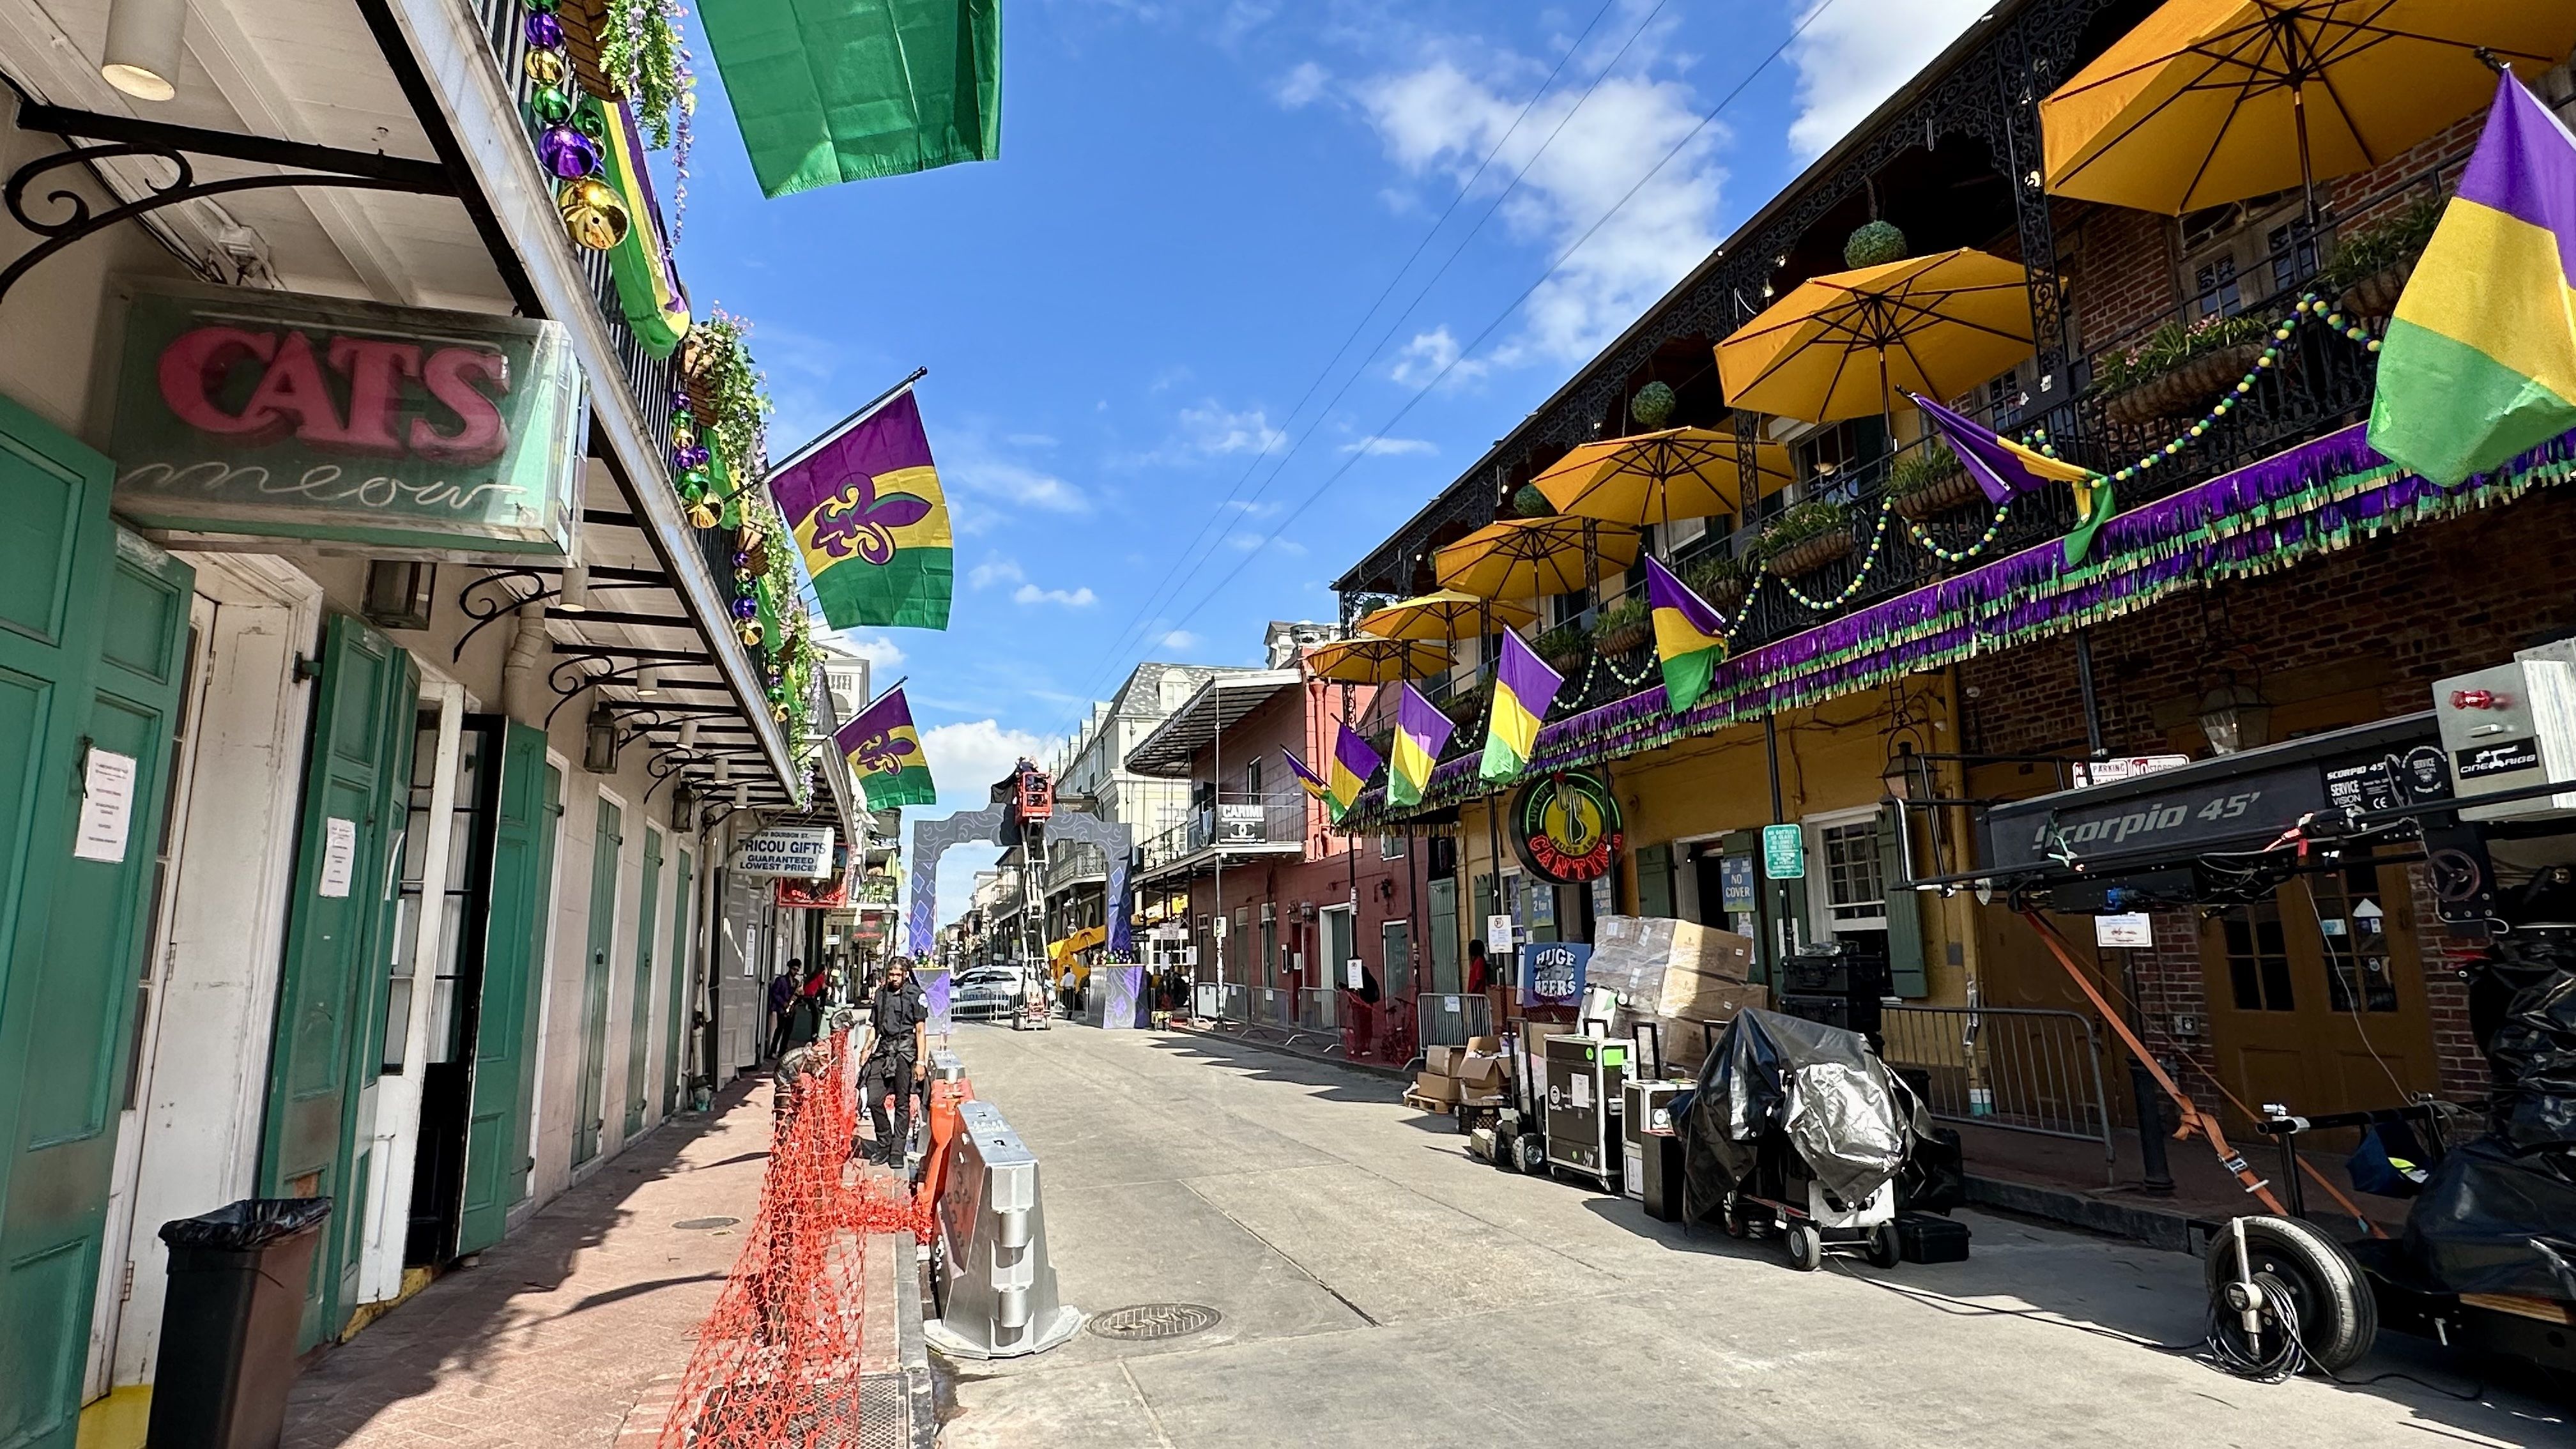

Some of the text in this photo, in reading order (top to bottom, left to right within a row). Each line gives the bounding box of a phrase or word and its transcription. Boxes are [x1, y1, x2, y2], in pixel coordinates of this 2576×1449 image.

[158, 325, 511, 461] CATS
[117, 461, 529, 509] meow
[2093, 763, 2125, 773] PARKING
[2133, 762, 2148, 776] NO
[2331, 780, 2359, 796] SERVICE
[2333, 793, 2361, 806] VISION
[2032, 792, 2261, 850] Scorpio 45'
[737, 839, 826, 854] TRICOU GIFTS
[740, 862, 781, 871] LOWEST
[747, 855, 815, 864] GUARANTEED
[1731, 873, 1743, 885] NO
[1725, 886, 1751, 898] COVER
[1533, 900, 1538, 912] 2
[1536, 948, 1575, 966] HUGE
[1535, 980, 1576, 997] BEERS
